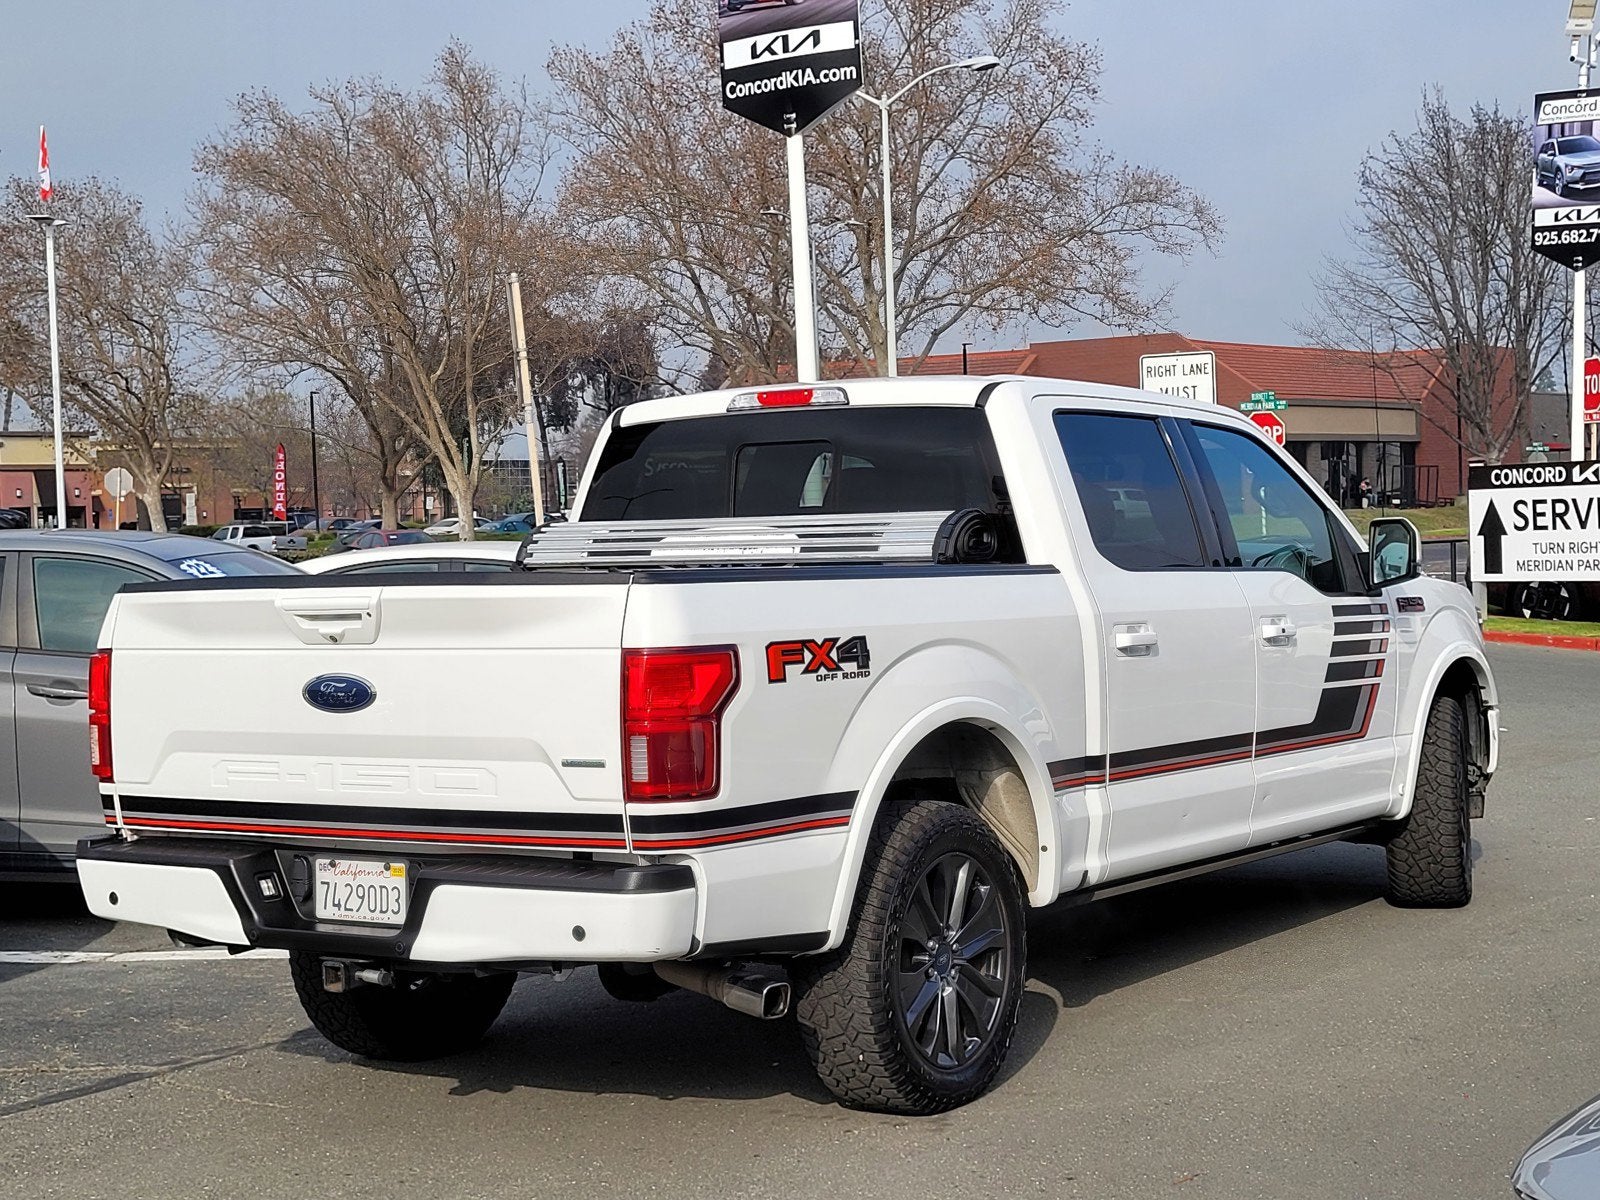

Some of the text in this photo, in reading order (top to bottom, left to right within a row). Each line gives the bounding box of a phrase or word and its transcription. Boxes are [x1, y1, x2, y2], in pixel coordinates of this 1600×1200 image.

[751, 29, 820, 60] KIA
[725, 65, 857, 99] ConcordKIA.com
[1542, 99, 1598, 116] Concord
[1534, 228, 1600, 245] 925.682.7
[1146, 362, 1209, 378] RIGHT LANE
[1262, 425, 1282, 441] OP
[1491, 466, 1566, 485] CONCORD
[1532, 542, 1565, 555] TURN
[1516, 559, 1574, 572] MERIDIAN
[765, 635, 871, 684] FX4
[815, 670, 871, 682] OFF ROAD
[318, 681, 357, 704] Ford
[211, 759, 499, 797] F-150
[333, 862, 385, 881] California
[320, 881, 401, 915] 74290D3
[337, 913, 385, 921] dmv.ca.gov
